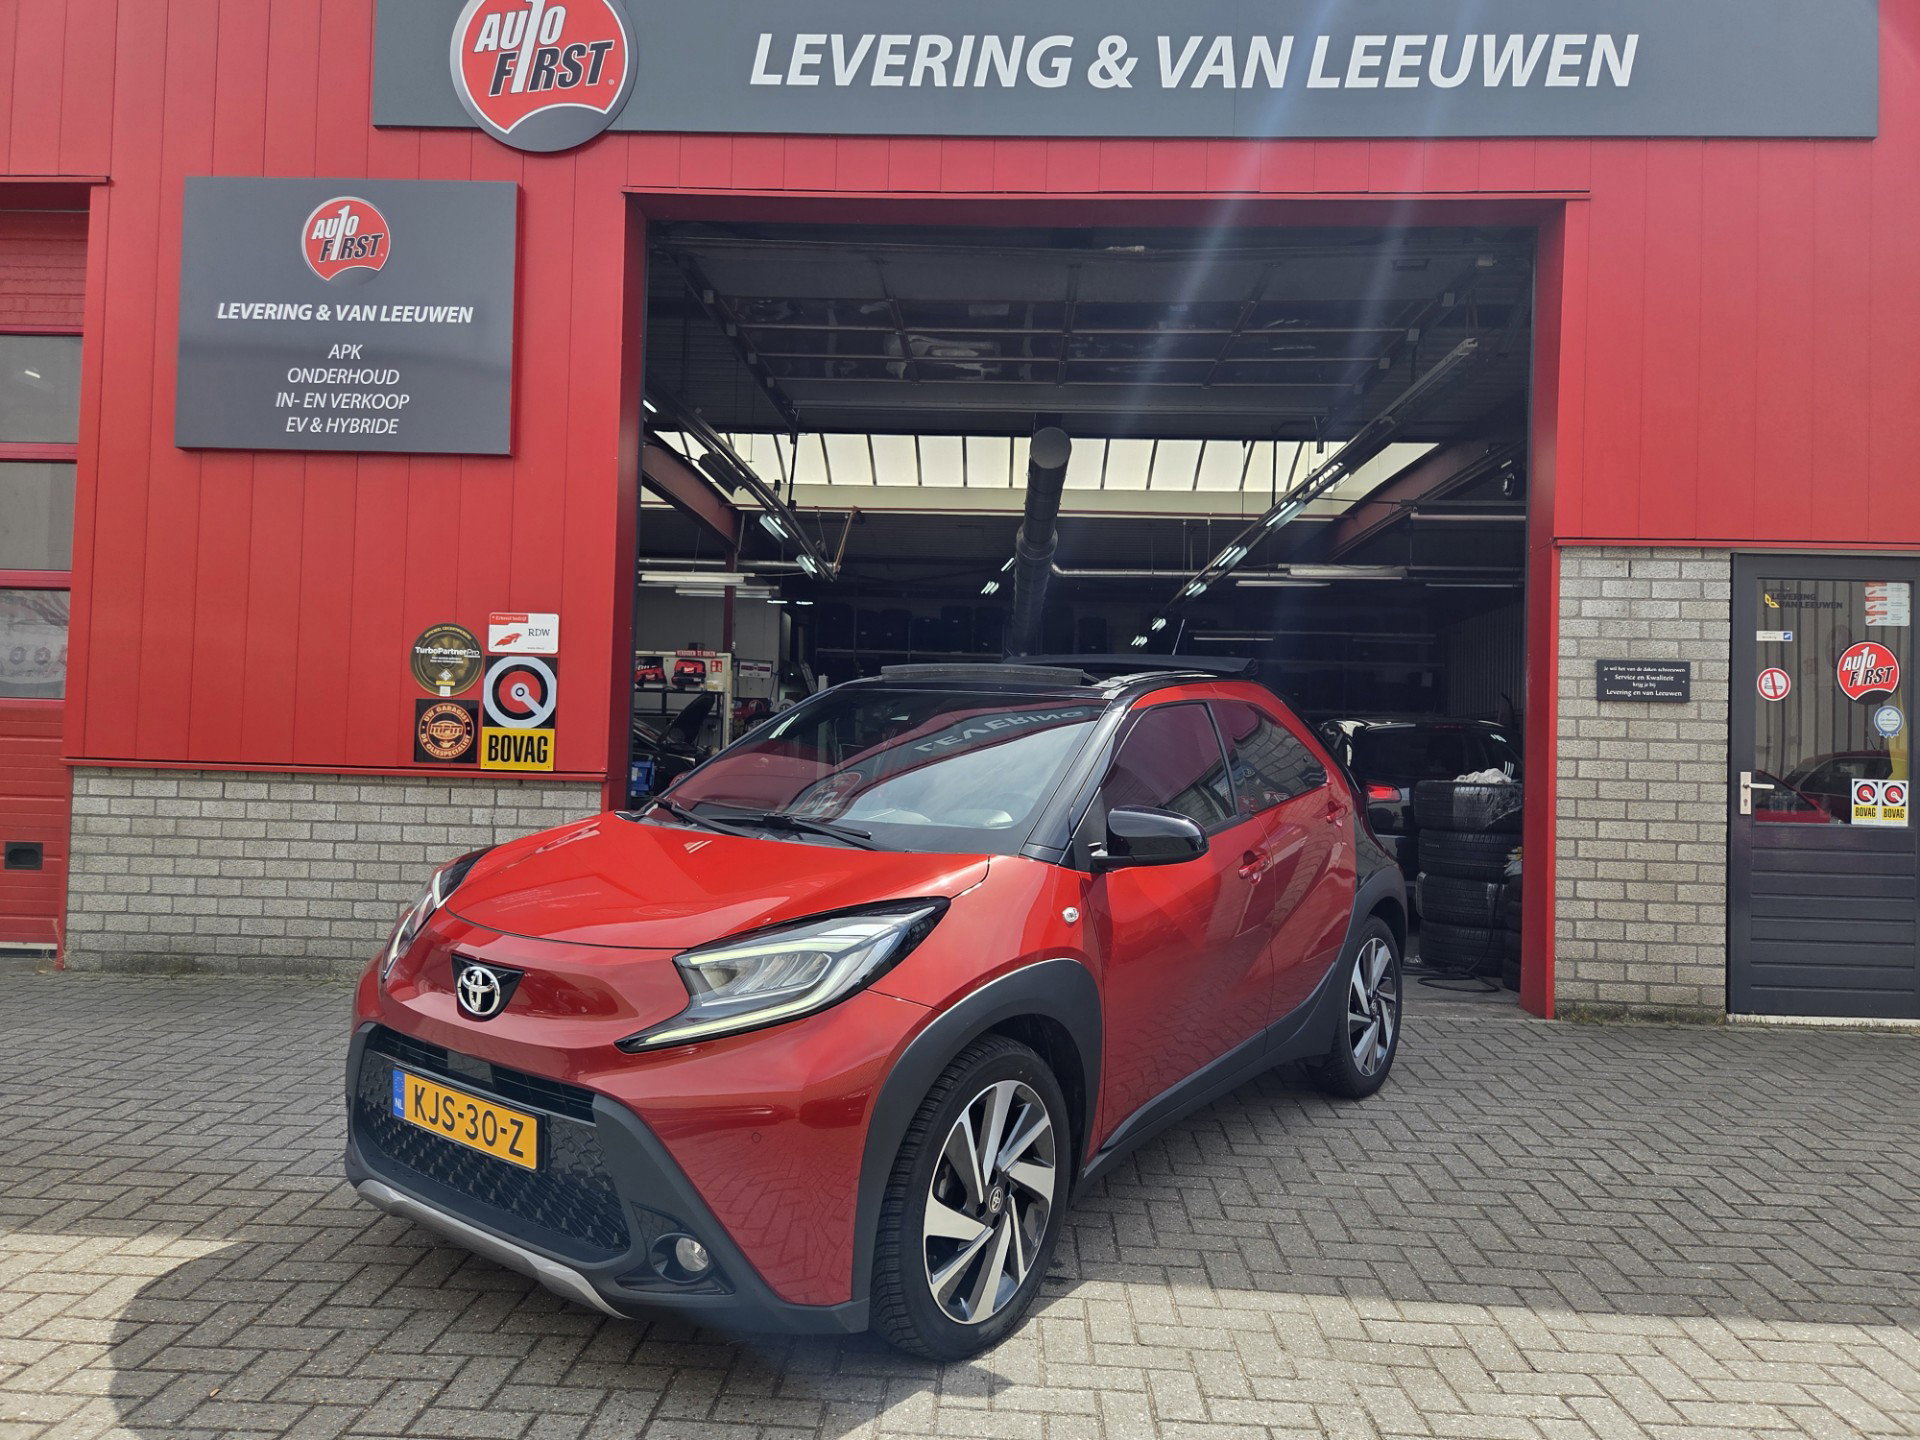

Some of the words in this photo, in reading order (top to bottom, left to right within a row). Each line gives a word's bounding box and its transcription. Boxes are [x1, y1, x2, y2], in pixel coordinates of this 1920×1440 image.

[489, 39, 615, 97] FIRST
[750, 33, 1074, 88] LEVERING
[1087, 34, 1139, 89] &
[1157, 35, 1294, 89] VAN
[1306, 33, 1640, 89] LEEUWEN
[318, 233, 385, 263] FIRST
[217, 303, 312, 321] LEVERING
[315, 304, 331, 321] &
[335, 305, 379, 322] VAN
[380, 305, 474, 324] LEEUWEN
[328, 344, 363, 360] APK
[287, 367, 400, 385] ONDERHOUD
[275, 392, 301, 408] IN-
[303, 393, 327, 409] EN
[329, 393, 410, 410] VERKOOP
[286, 417, 309, 433] EV
[310, 417, 323, 433] &
[325, 417, 399, 435] HYBRIDE
[1772, 593, 1816, 601] LEVERING
[1799, 601, 1843, 609] LEEUWEN
[528, 628, 551, 637] RDW
[1849, 665, 1894, 687] FIRST
[1606, 689, 1632, 697] Levering
[423, 709, 435, 722] UW
[436, 705, 470, 723] GARAGIST
[488, 734, 549, 763] BOVAG
[1855, 806, 1876, 818] BOVAG
[1883, 807, 1905, 819] BOVAG
[414, 1084, 524, 1158] KJS-30-Z
